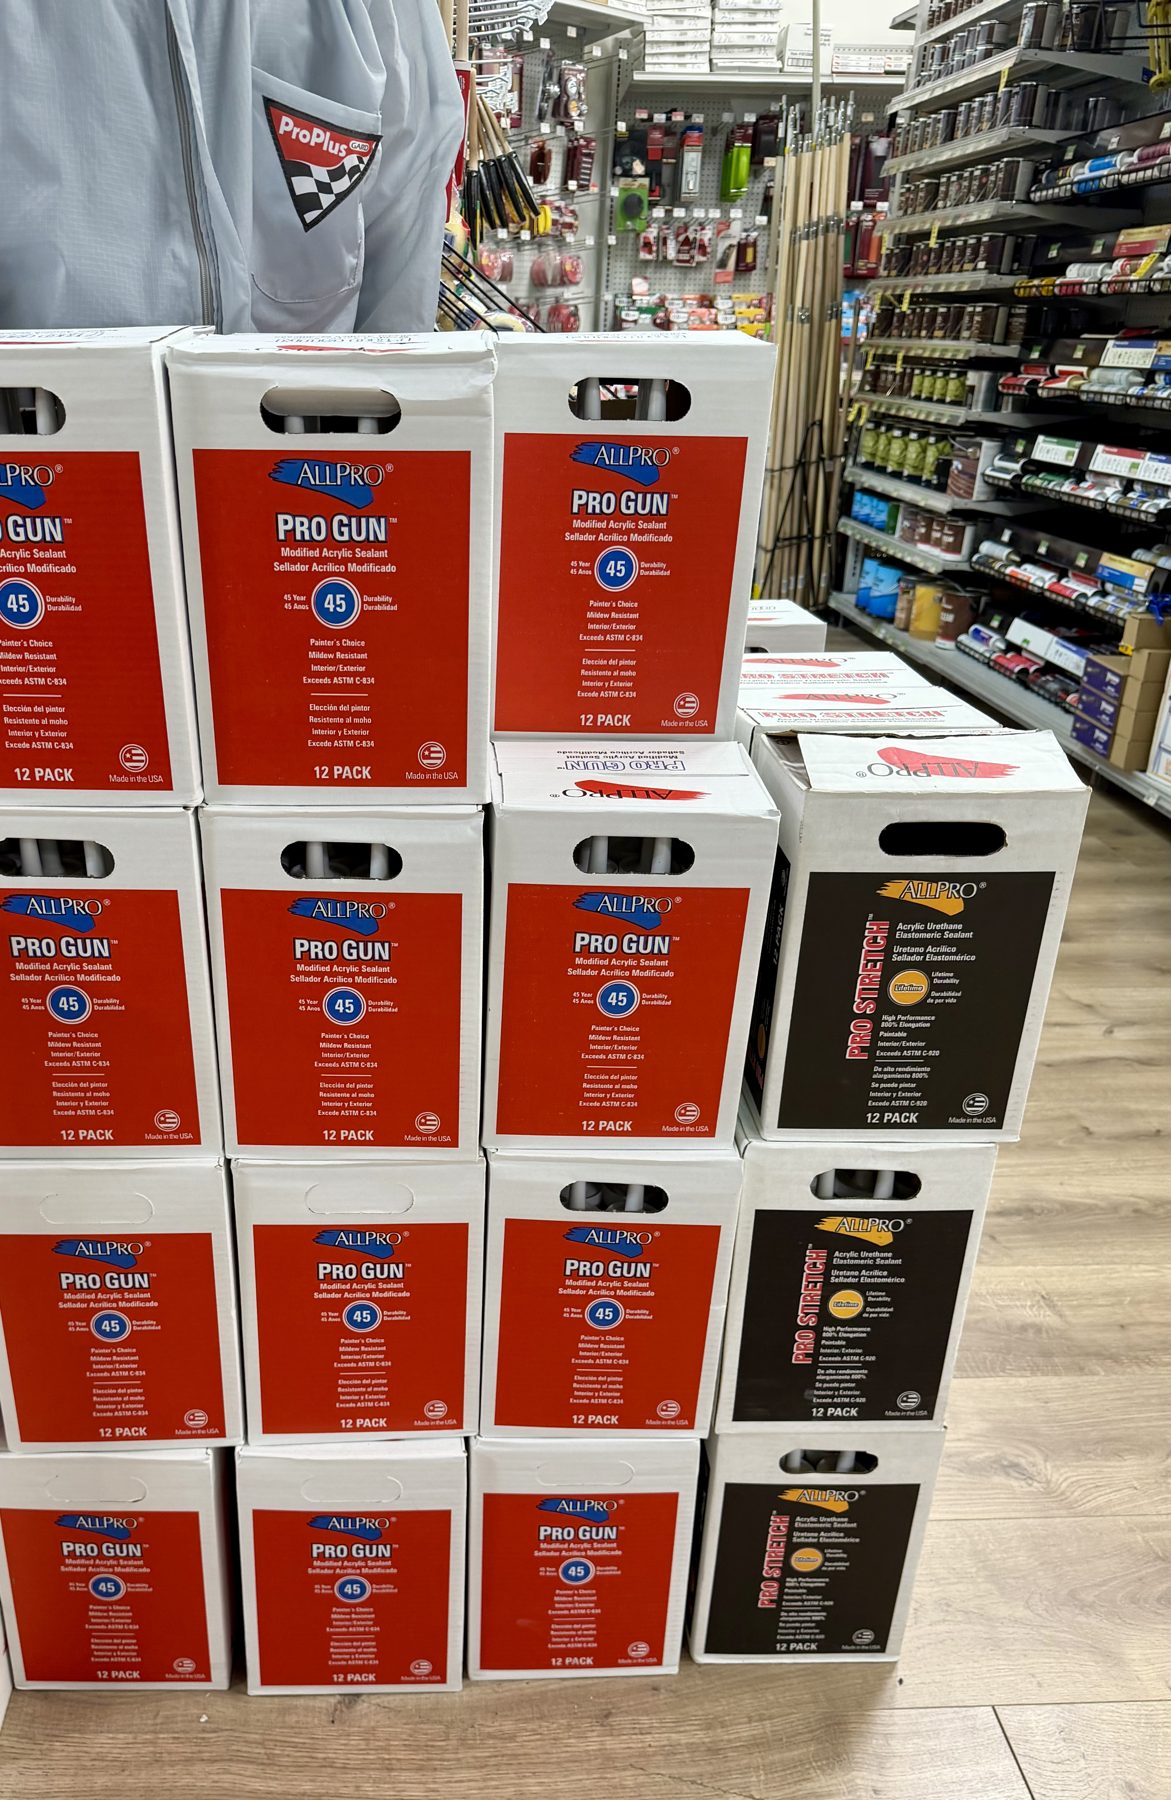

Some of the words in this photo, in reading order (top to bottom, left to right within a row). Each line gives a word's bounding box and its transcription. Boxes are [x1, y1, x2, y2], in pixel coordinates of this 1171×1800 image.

[278, 116, 348, 157] ProPlus
[573, 490, 615, 513] PRO
[621, 492, 668, 514] GUN
[8, 516, 62, 541] GUN
[278, 514, 326, 540] PRO
[333, 515, 385, 541] GUN
[281, 548, 319, 557] Modified
[322, 548, 352, 559] Acrylic
[356, 548, 388, 557] Sealant
[274, 562, 309, 571] Sellador
[348, 563, 396, 572] Modificado
[606, 561, 625, 576] 45
[8, 594, 29, 612] 45
[324, 594, 346, 612] 45
[364, 602, 397, 610] Durabilidad
[580, 714, 593, 725] 12
[598, 714, 631, 726] PACK
[314, 766, 329, 778] 12
[334, 766, 371, 778] PACK
[565, 761, 625, 771] GUN
[630, 761, 685, 771] PRO
[15, 768, 30, 780] 12
[35, 768, 74, 781] PACK
[896, 930, 941, 938] Elastomeric
[897, 923, 924, 932] Acrylic
[11, 937, 55, 956] PRO
[61, 937, 109, 956] GUN
[295, 940, 337, 959] PRO
[343, 940, 389, 960] GUN
[575, 933, 617, 953] PRO
[623, 934, 669, 954] GUN
[853, 922, 889, 1014] STRETCH
[59, 997, 78, 1010] 45
[608, 992, 627, 1006] 45
[335, 1000, 354, 1013] 45
[846, 1019, 873, 1059] PRO
[867, 1113, 880, 1123] 12
[884, 1113, 918, 1123] PACK
[582, 1121, 594, 1130] 12
[599, 1121, 632, 1130] PACK
[61, 1130, 75, 1140] 12
[79, 1130, 113, 1140] PACK
[323, 1130, 336, 1140] 12
[341, 1130, 373, 1140] PACK
[319, 1264, 356, 1279] PRO
[362, 1263, 402, 1278] GUN
[566, 1260, 604, 1276] PRO
[608, 1261, 650, 1277] GUN
[61, 1274, 100, 1288] PRO
[105, 1273, 148, 1288] GUN
[797, 1250, 827, 1326] STRETCH
[354, 1311, 370, 1322] 45
[596, 1308, 612, 1320] 45
[102, 1320, 120, 1332] 45
[792, 1330, 815, 1363] PRO
[812, 1408, 824, 1416] 12
[827, 1408, 858, 1416] PACK
[341, 1419, 352, 1428] 12
[356, 1418, 386, 1428] PACK
[573, 1415, 584, 1423] 12
[588, 1415, 618, 1424] PACK
[100, 1428, 112, 1436] 12
[116, 1427, 147, 1436] PACK
[540, 1526, 574, 1540] PRO
[579, 1526, 616, 1540] GUN
[62, 1542, 98, 1556] PRO
[102, 1543, 141, 1556] GUN
[312, 1544, 347, 1556] PRO
[352, 1544, 390, 1556] GUN
[763, 1516, 789, 1577] STRETCH
[568, 1566, 584, 1576] 45
[99, 1582, 115, 1591] 45
[344, 1584, 360, 1592] 45
[758, 1581, 779, 1607] PRO
